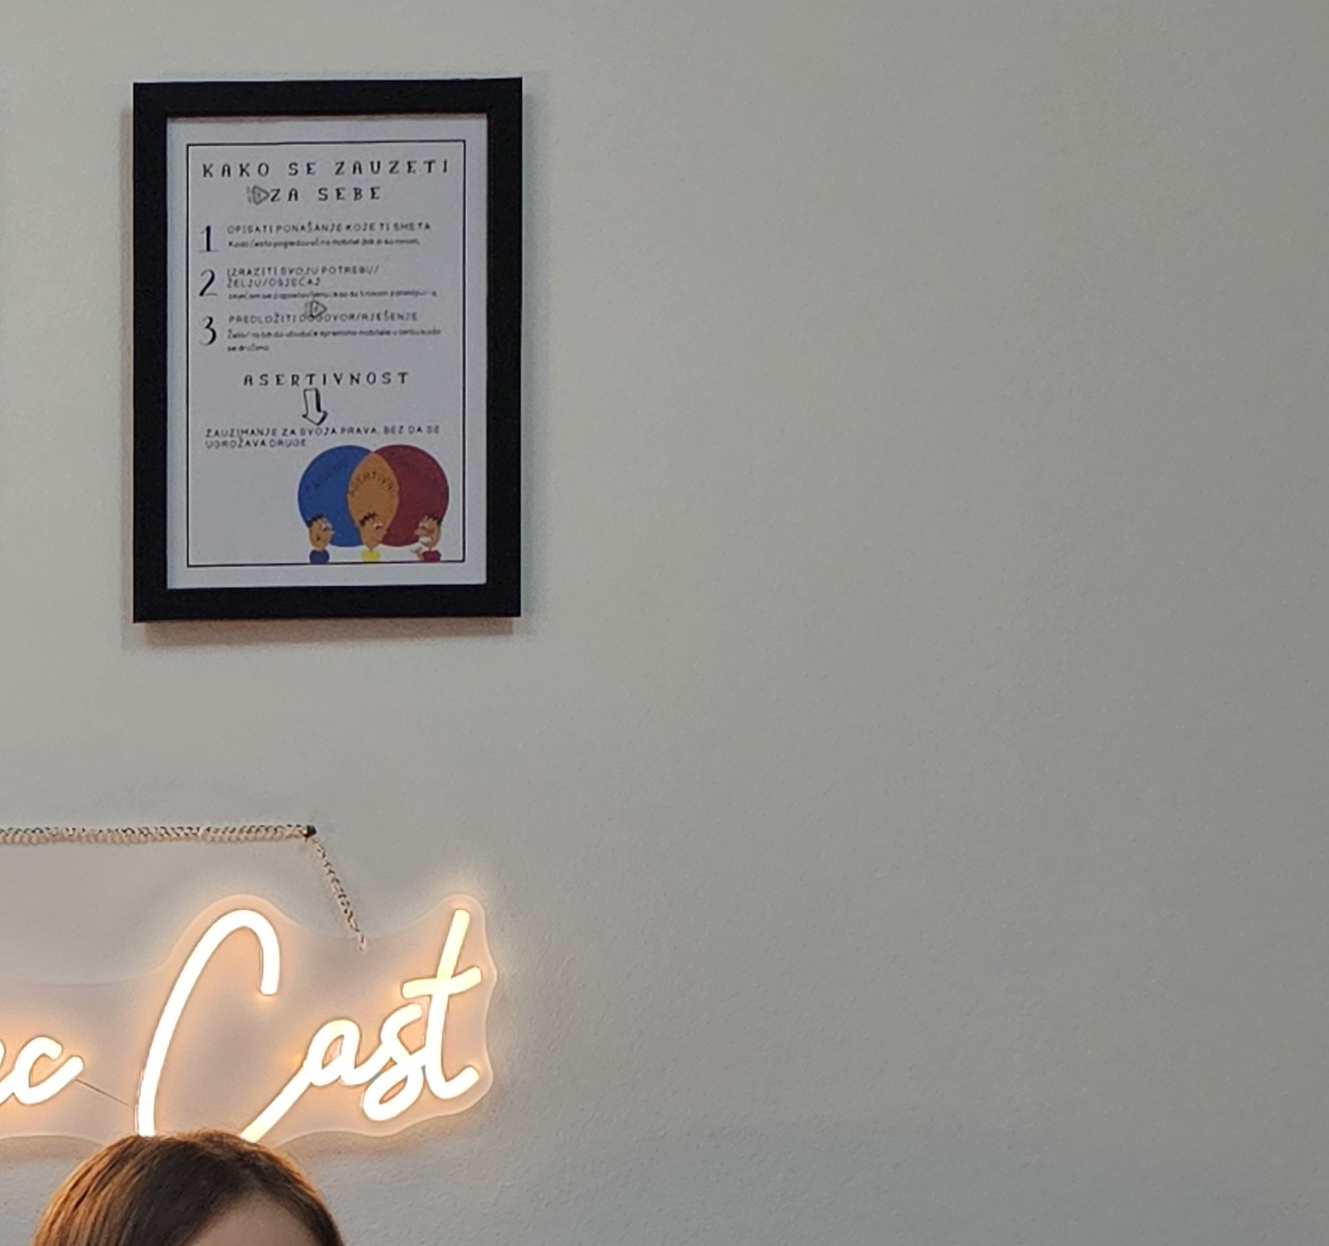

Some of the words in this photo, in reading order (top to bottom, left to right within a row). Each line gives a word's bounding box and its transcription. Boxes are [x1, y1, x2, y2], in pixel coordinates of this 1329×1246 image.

[203, 163, 270, 177] KAKO
[288, 163, 316, 176] SE
[335, 160, 448, 175] ZAUZETI
[270, 188, 299, 202] ZA
[318, 186, 381, 201] SEBE
[198, 224, 217, 252] 1
[199, 268, 217, 296] 2
[199, 315, 216, 346] 3
[244, 372, 409, 386] ASERTIVNOST
[135, 908, 484, 1140] Cast
